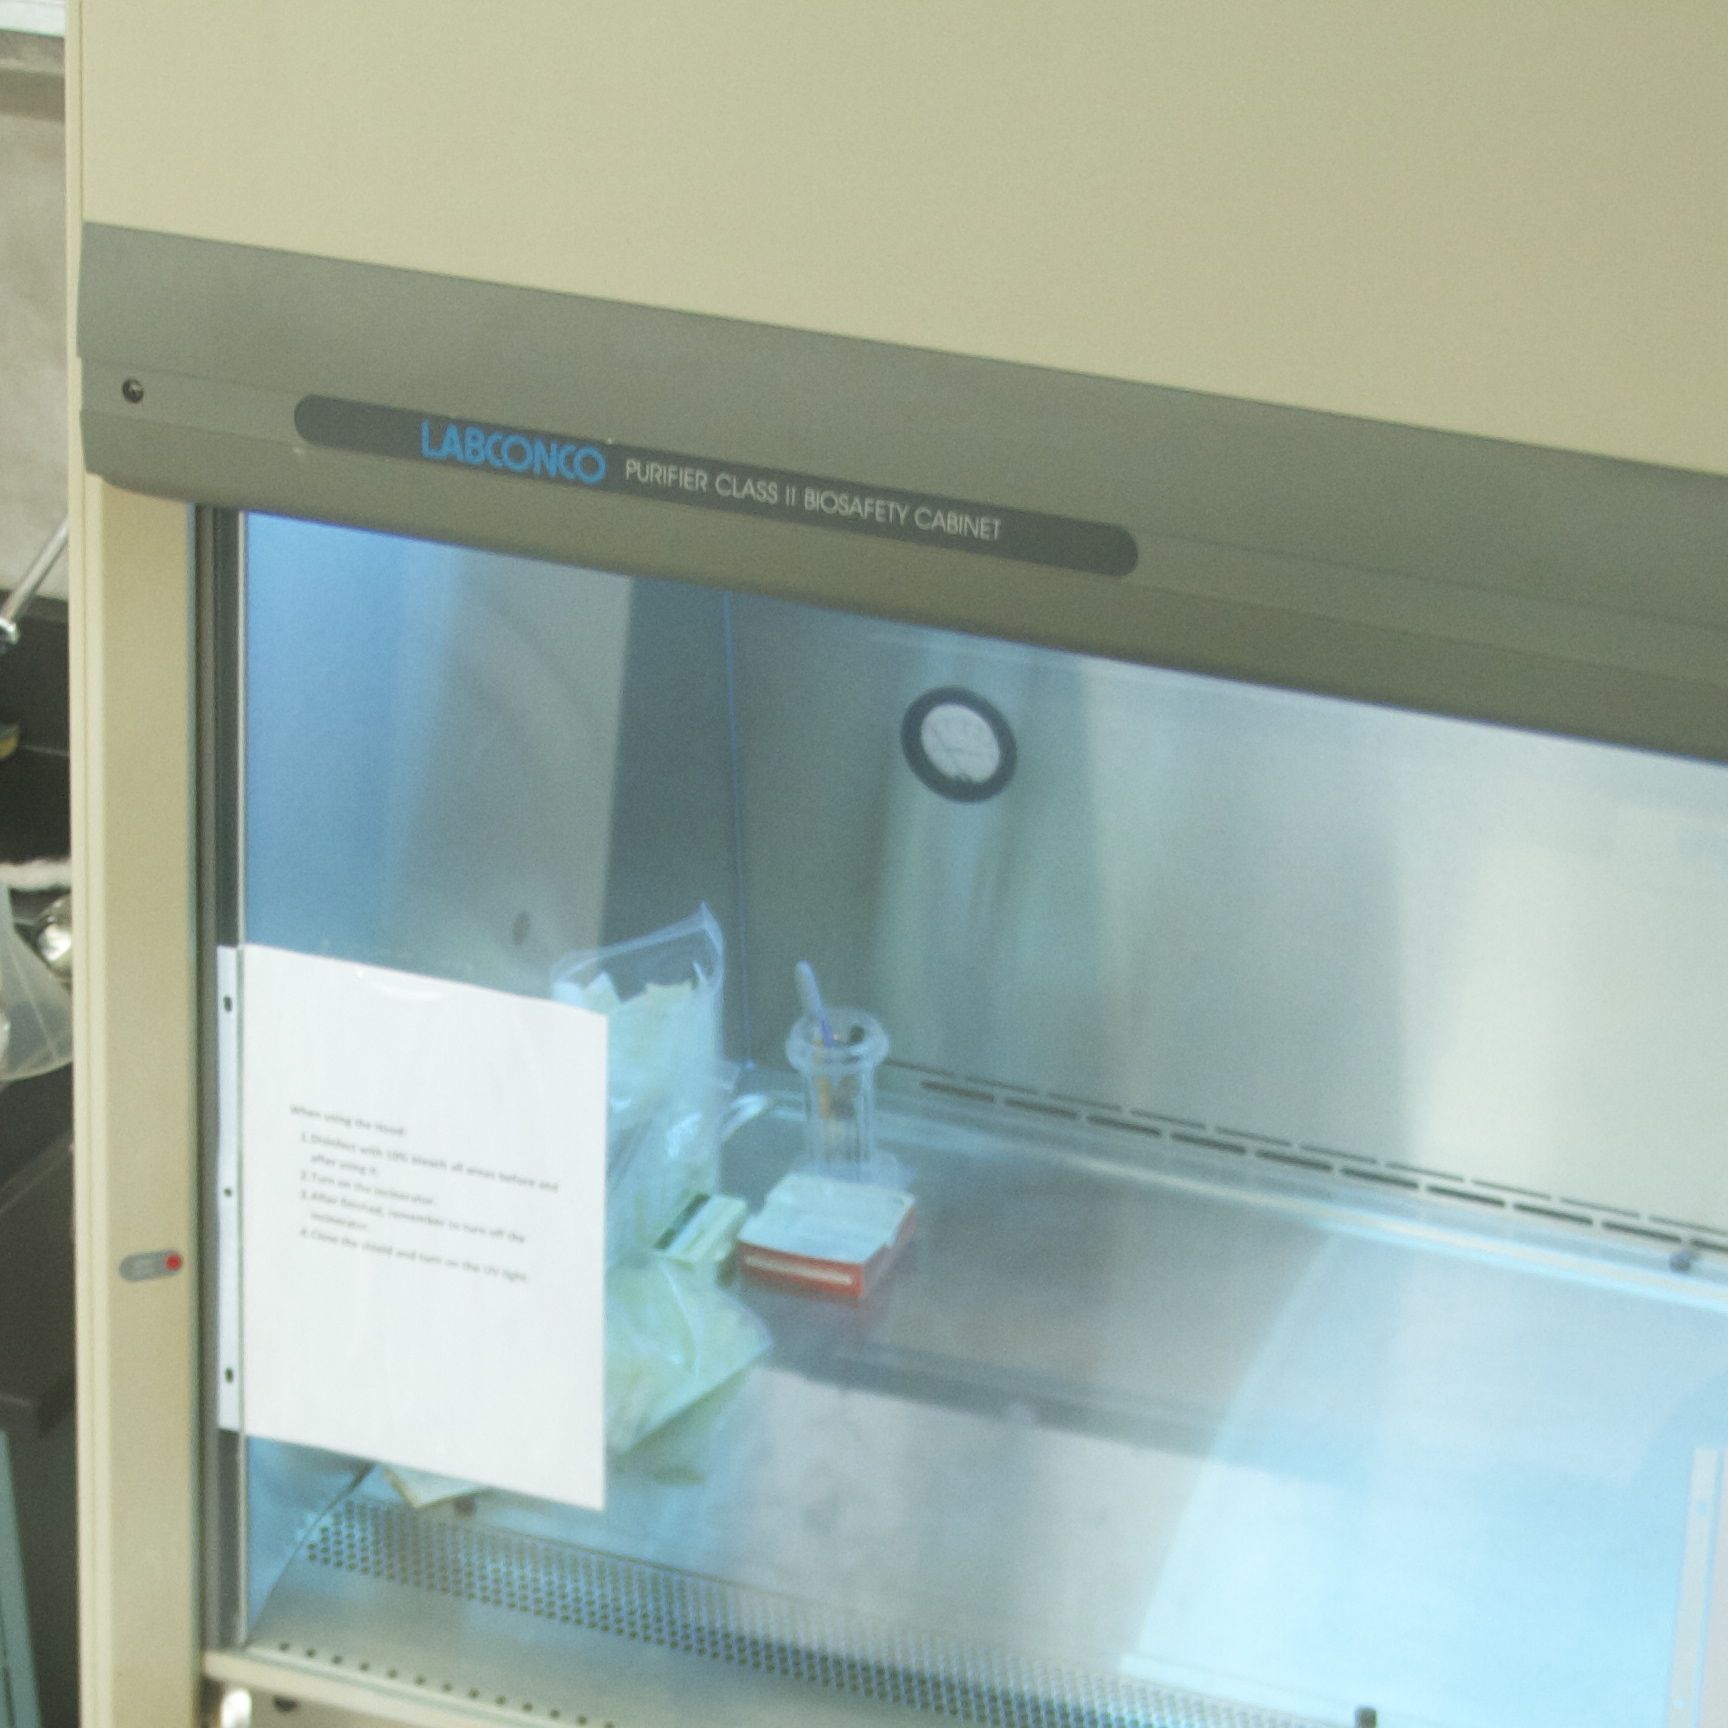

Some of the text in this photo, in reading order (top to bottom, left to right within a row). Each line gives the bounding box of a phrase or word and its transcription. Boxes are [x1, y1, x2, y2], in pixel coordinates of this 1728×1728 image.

[421, 419, 1002, 541] LABCONCO PURIFIER CLASS II BIOSAFETY CABINET
[290, 1105, 320, 1117] When
[324, 1114, 351, 1127] using
[355, 1118, 371, 1129] the
[354, 1182, 371, 1194] the
[342, 1235, 358, 1248] the
[507, 1230, 526, 1244] the
